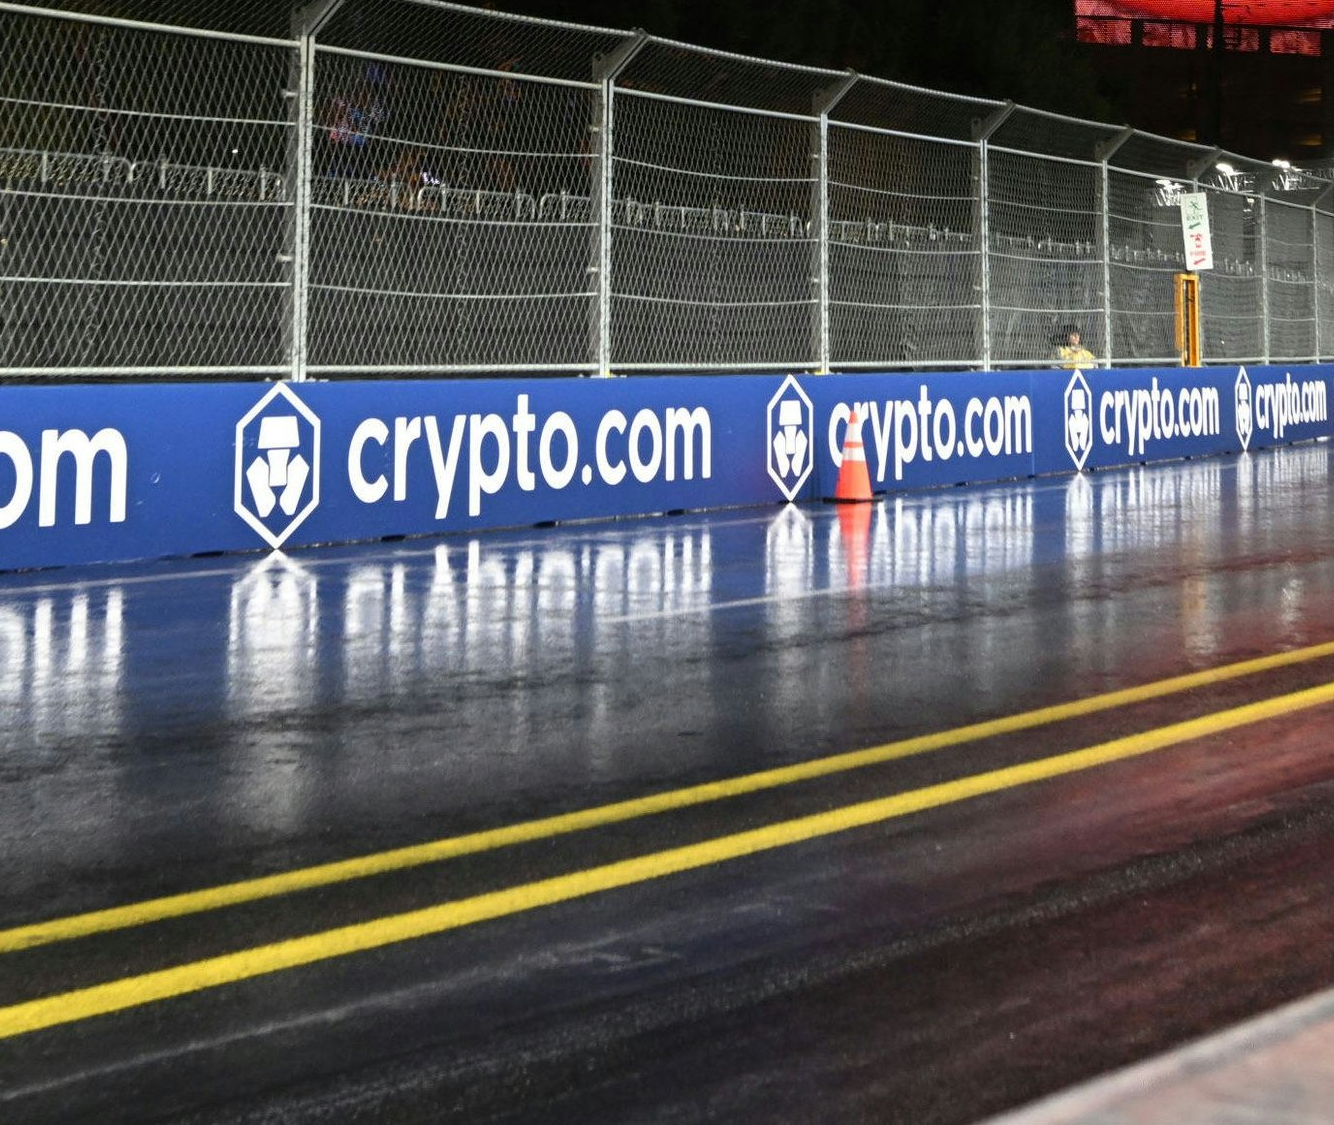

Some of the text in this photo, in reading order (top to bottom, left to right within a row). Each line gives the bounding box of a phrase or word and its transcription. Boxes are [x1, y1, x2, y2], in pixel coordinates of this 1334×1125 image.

[1100, 377, 1220, 455] crypto.com
[1255, 373, 1327, 438] crypto.com
[348, 393, 712, 519] crypto.com
